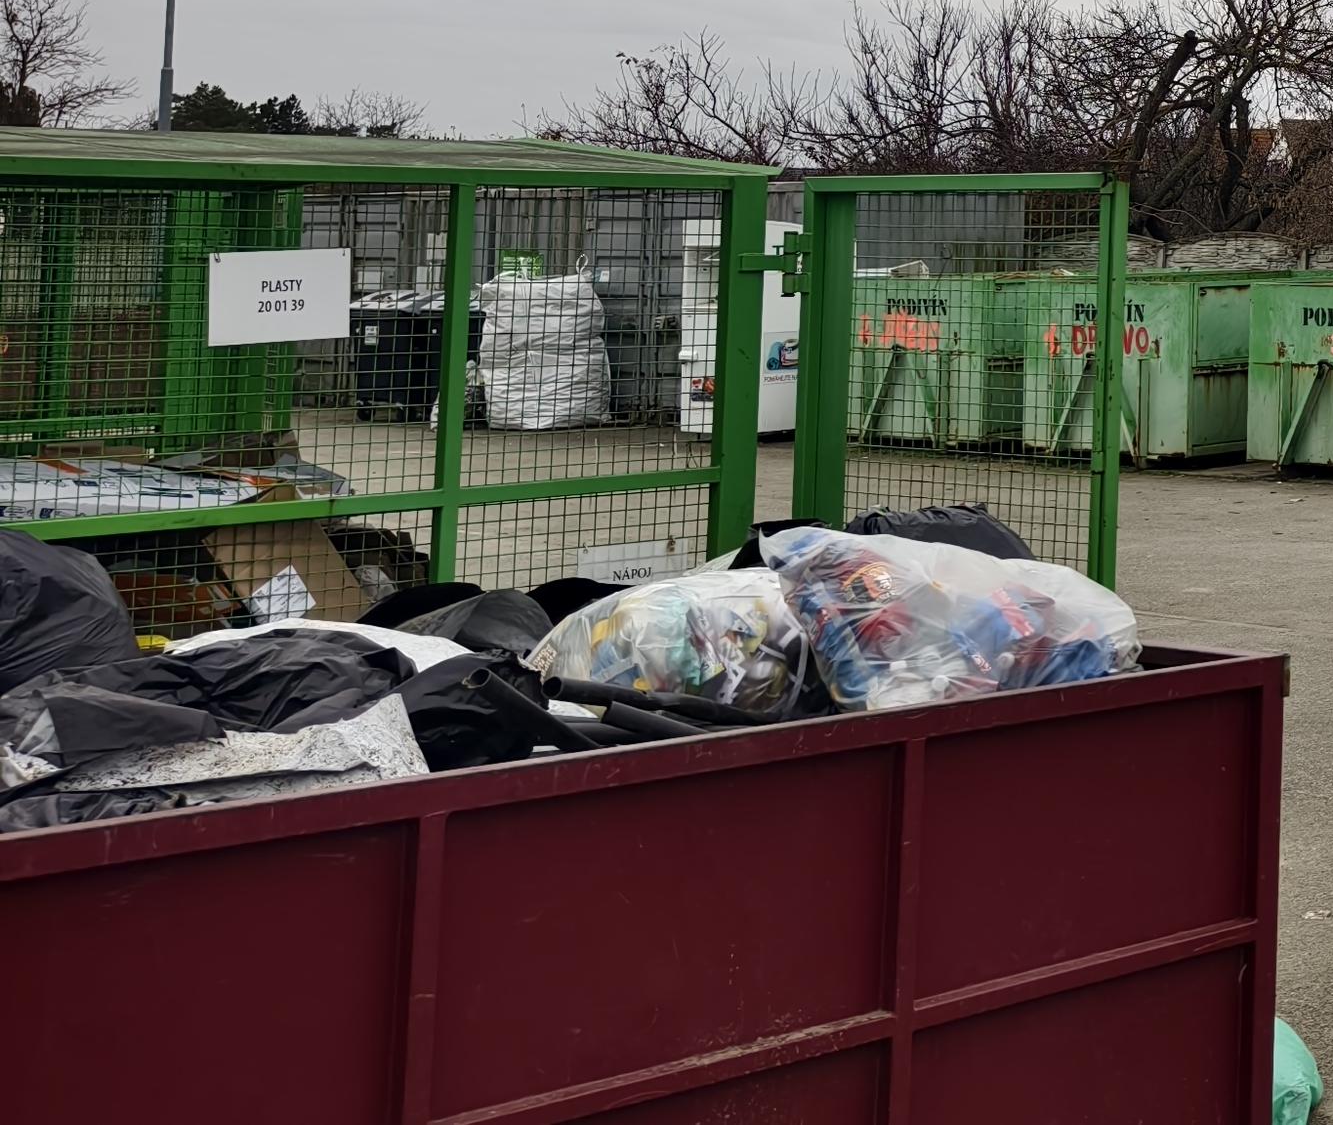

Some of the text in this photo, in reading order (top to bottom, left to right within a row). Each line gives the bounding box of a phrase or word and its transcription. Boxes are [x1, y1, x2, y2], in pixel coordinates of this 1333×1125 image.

[261, 279, 303, 293] PLASTY
[258, 299, 305, 313] 20 01 39
[887, 294, 948, 316] PODIVÍN
[612, 567, 652, 581] NÁPOJ
